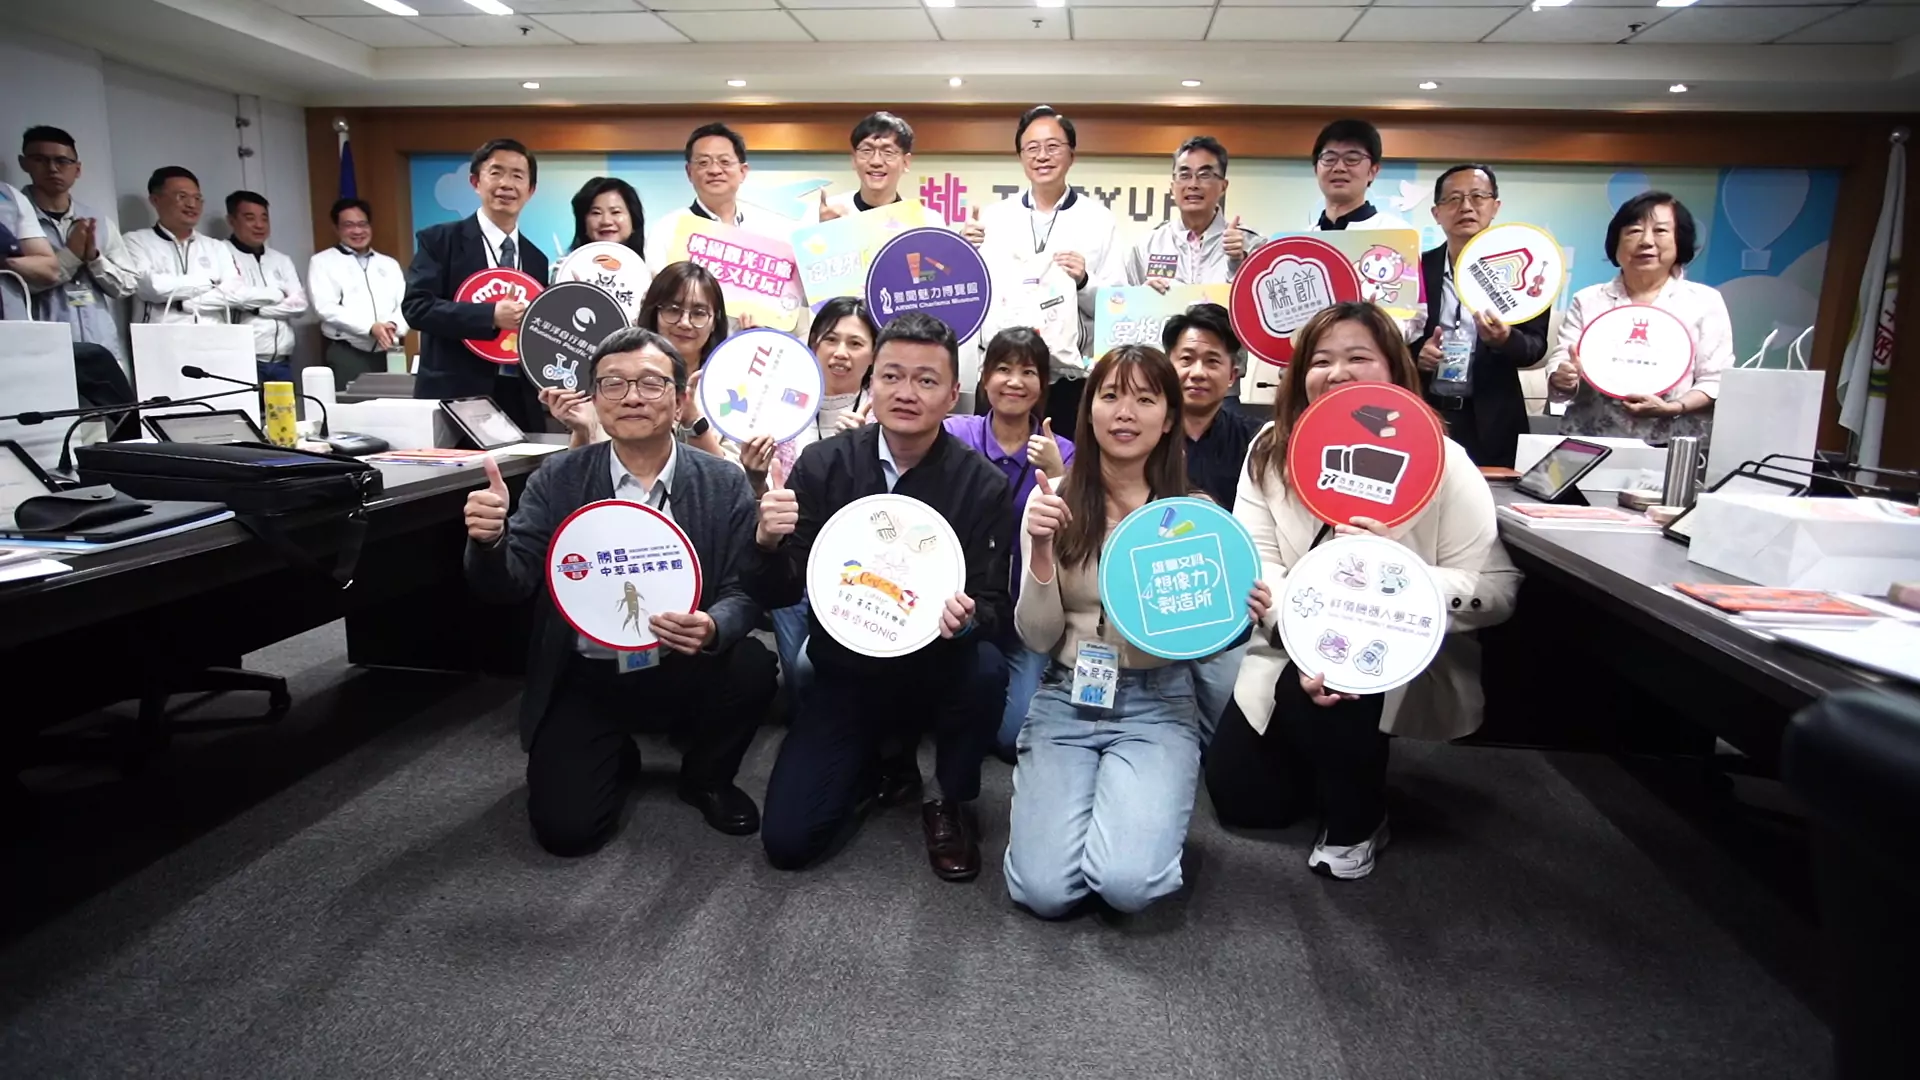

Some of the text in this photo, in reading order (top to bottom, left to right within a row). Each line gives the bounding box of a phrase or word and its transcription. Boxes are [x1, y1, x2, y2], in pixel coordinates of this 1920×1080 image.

[688, 233, 793, 279] 桃園觀光工廠
[529, 325, 588, 359] Museum Pacific
[748, 346, 773, 377] TTL
[1320, 473, 1339, 487] 77
[600, 558, 684, 577] 中草藥探索館
[1154, 569, 1208, 594] 想像力
[1157, 588, 1212, 615] 製造所
